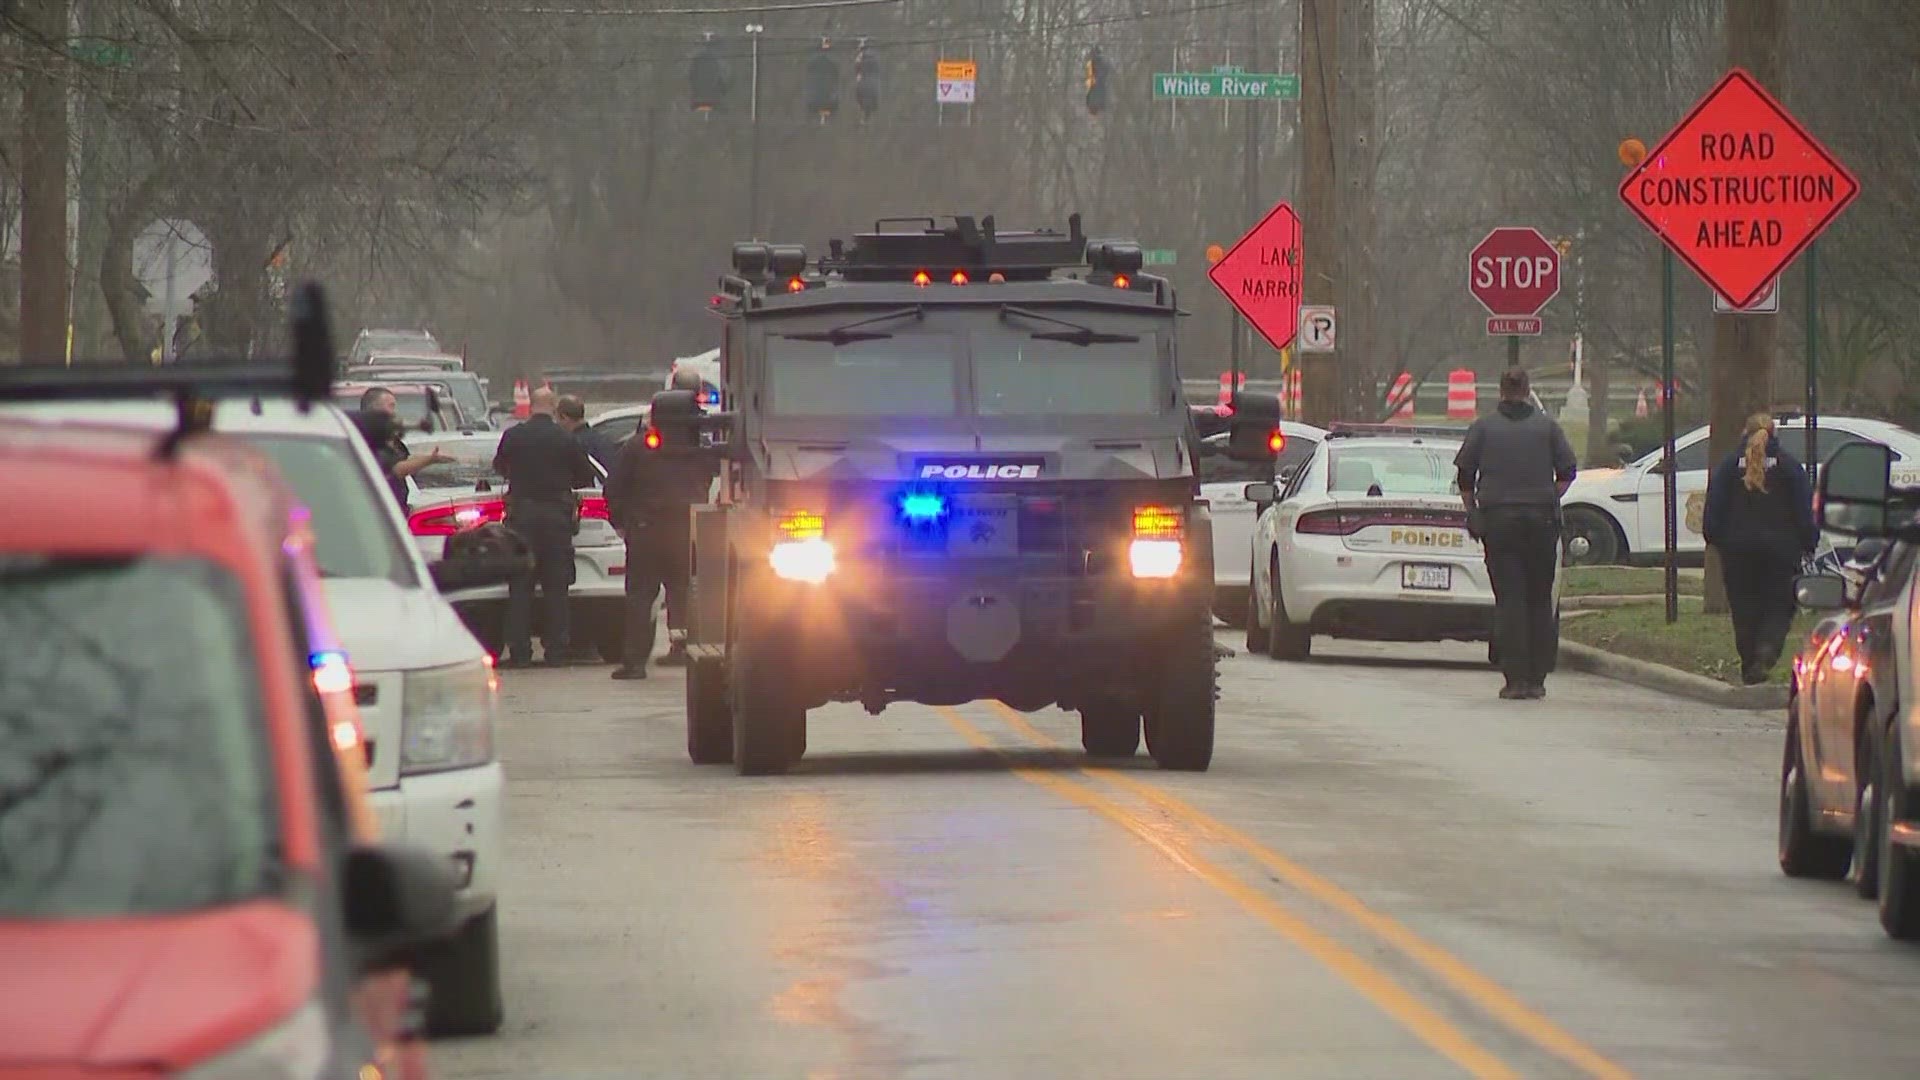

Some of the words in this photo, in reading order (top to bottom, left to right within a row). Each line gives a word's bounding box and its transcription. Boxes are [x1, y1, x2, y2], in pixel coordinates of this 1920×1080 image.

[1163, 77, 1211, 95] White
[1222, 77, 1268, 96] River
[1701, 133, 1774, 161] ROAD
[1640, 175, 1834, 206] CONSTRUCTION
[1696, 220, 1782, 248] AHEAD
[1476, 256, 1554, 289] STOP
[1242, 278, 1299, 298] NARRO
[1314, 317, 1332, 341] P
[1492, 321, 1512, 332] ALL
[1517, 321, 1536, 332] WAY
[920, 465, 1040, 478] POLICE
[1891, 473, 1920, 485] POL
[1391, 530, 1464, 547] POLICE
